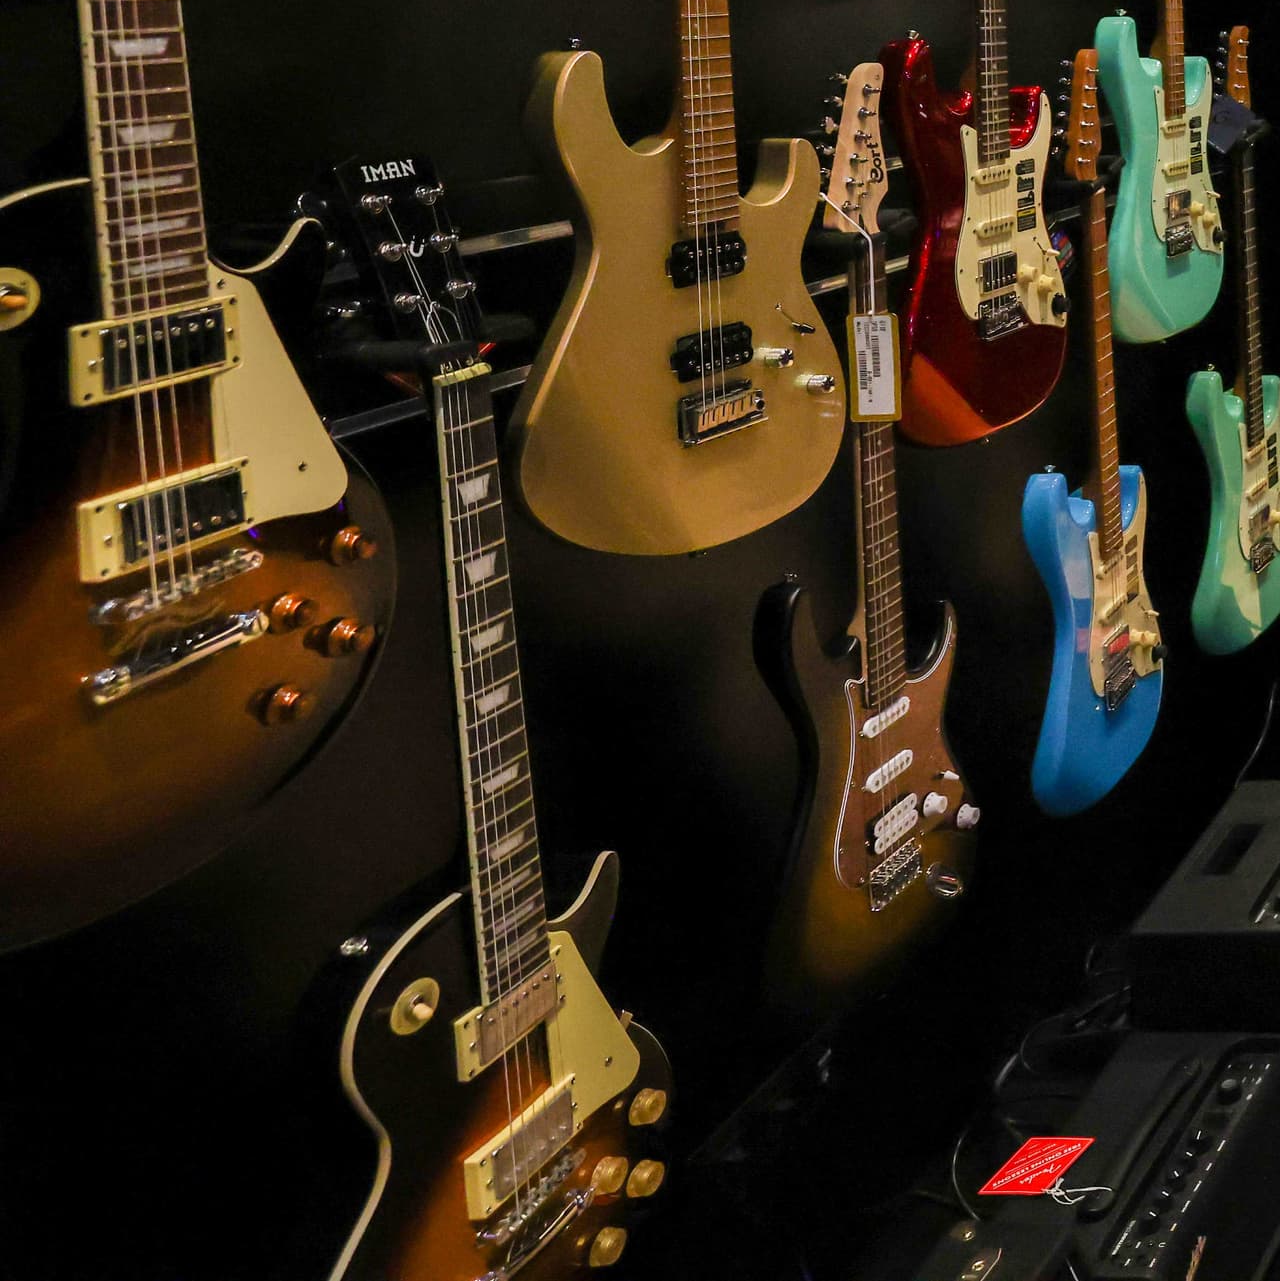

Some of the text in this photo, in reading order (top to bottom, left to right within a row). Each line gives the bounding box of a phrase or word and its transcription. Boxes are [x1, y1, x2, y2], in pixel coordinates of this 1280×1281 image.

[360, 159, 416, 183] IMAN
[866, 140, 884, 184] Cort
[1019, 1163, 1062, 1185] Fender
